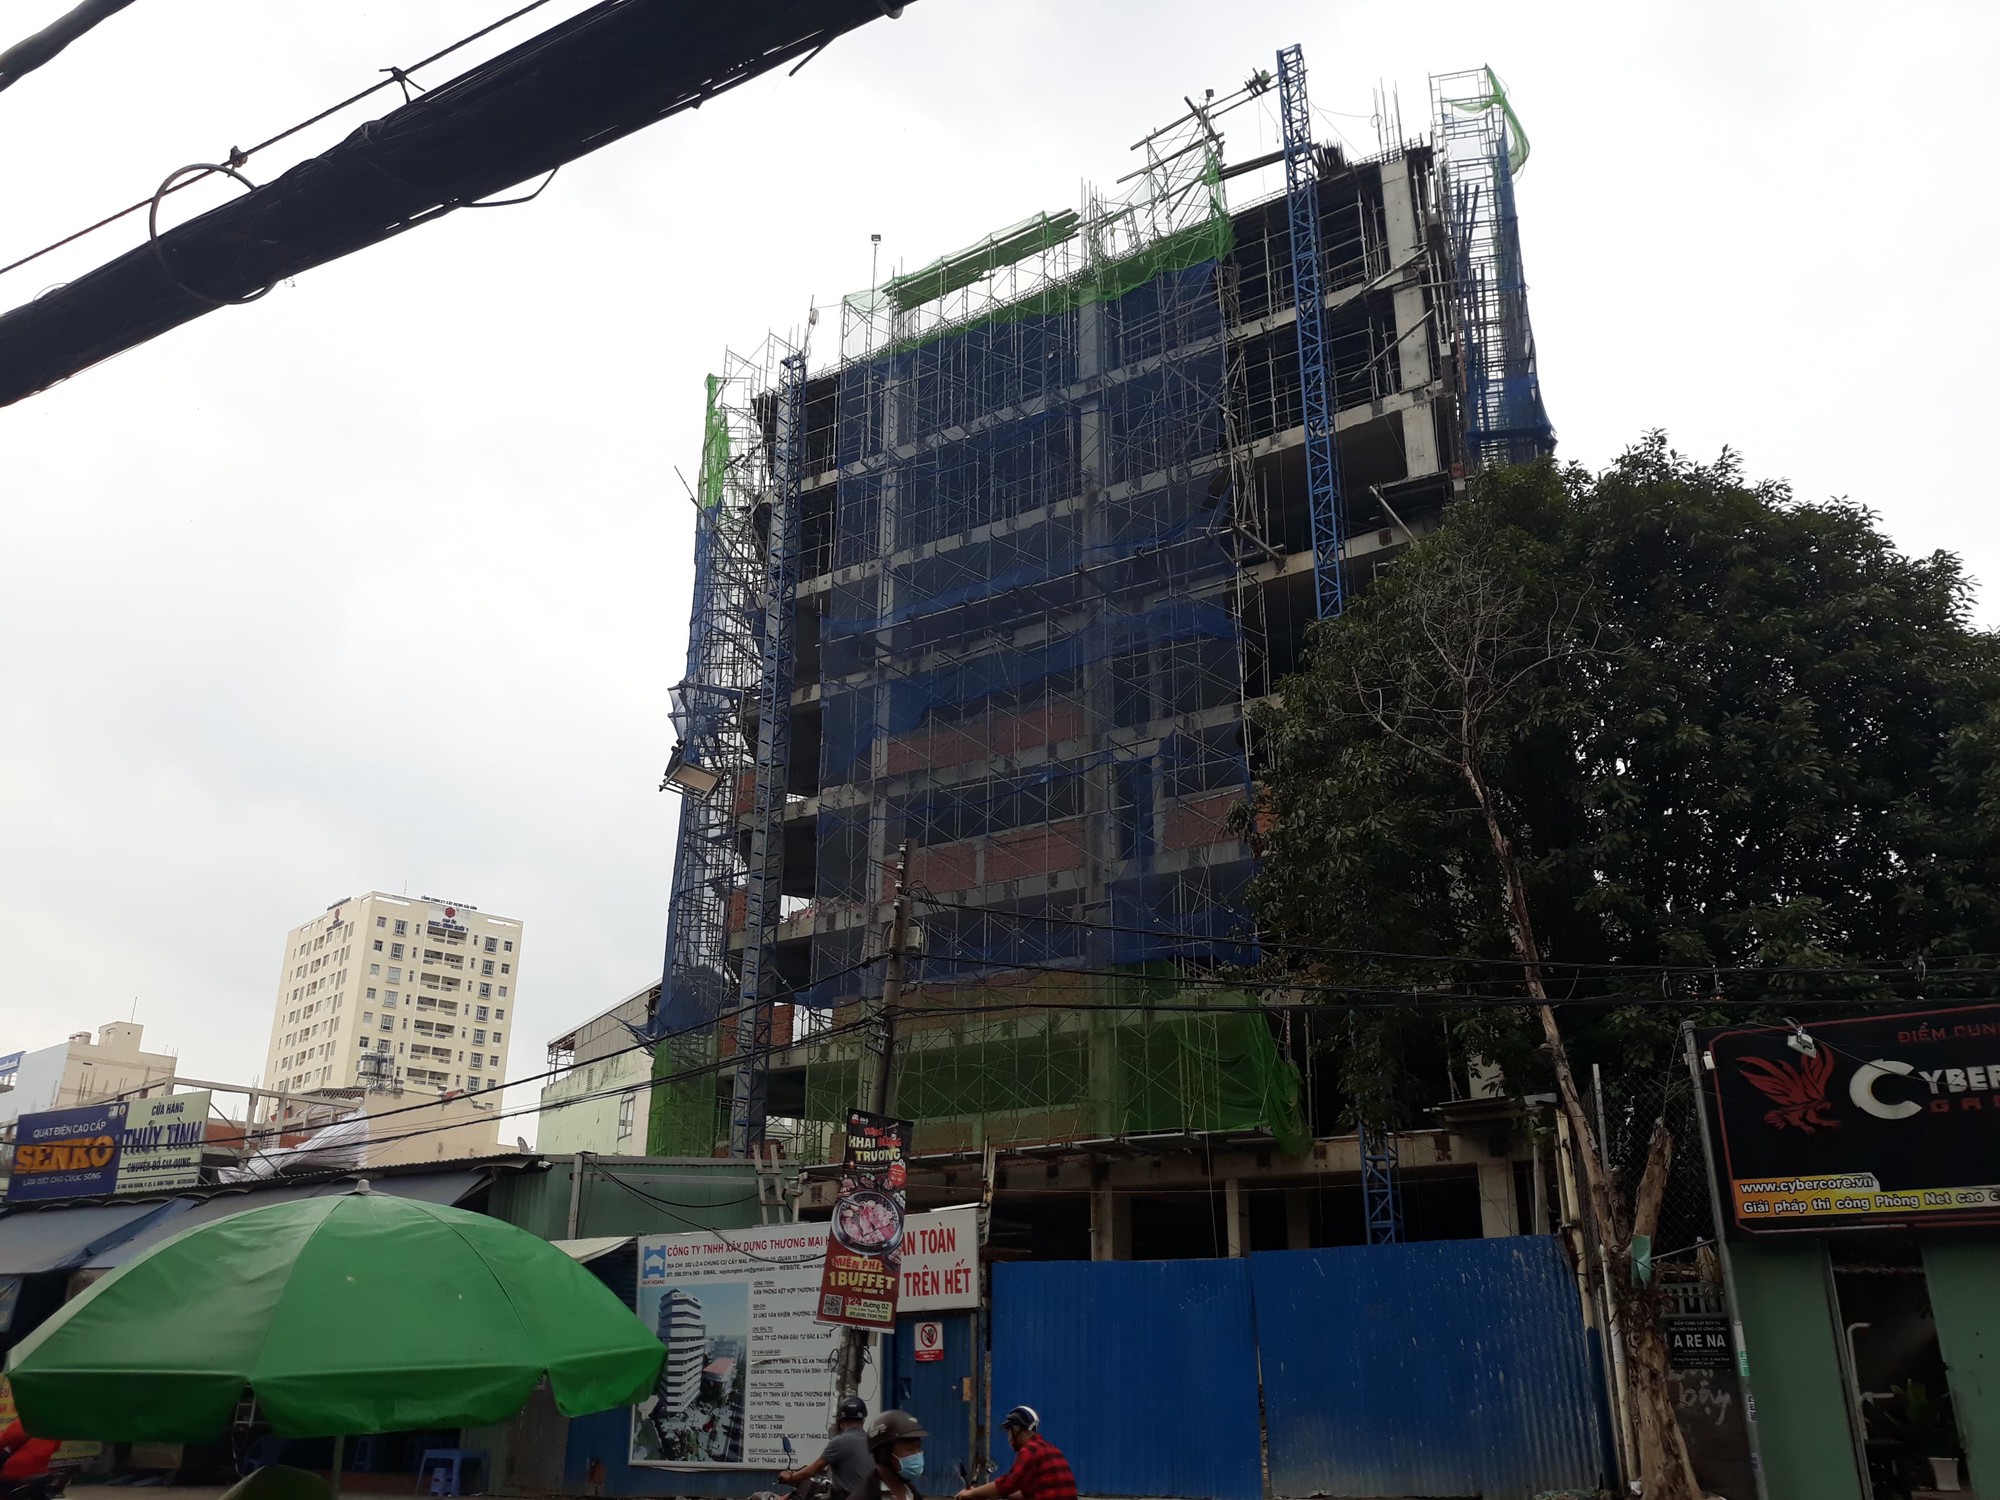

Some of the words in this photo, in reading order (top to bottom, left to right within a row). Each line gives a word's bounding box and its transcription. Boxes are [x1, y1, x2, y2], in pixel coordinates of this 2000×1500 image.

[1898, 1022, 1945, 1043] ĐIỂM
[1954, 1023, 2000, 1037] CUN
[72, 1124, 88, 1133] CAO
[90, 1118, 106, 1131] CẤP
[848, 1135, 876, 1148] KHAI
[15, 1136, 114, 1174] SENKO
[1741, 1177, 1873, 1193] www.cybercore.vn
[1743, 1200, 1769, 1213] Giải
[1774, 1198, 1808, 1213] pháp
[1812, 1198, 1830, 1210] thi
[1836, 1195, 1870, 1210] công
[1875, 1193, 1919, 1208] Phòng
[1923, 1192, 1951, 1205] Net
[1957, 1192, 1984, 1203] cao
[667, 1245, 689, 1256] CÔNG
[692, 1246, 700, 1254] TY
[703, 1244, 724, 1254] TNHH
[726, 1241, 742, 1253] XÂY
[744, 1240, 767, 1253] DỰNG
[770, 1238, 805, 1249] THƯƠNG
[808, 1236, 822, 1248] MẠI
[901, 1231, 916, 1256] AN
[920, 1222, 956, 1254] TOÀN
[838, 1272, 895, 1289] BUFFET
[904, 1264, 939, 1297] TRÊN
[944, 1259, 971, 1295] HẾT
